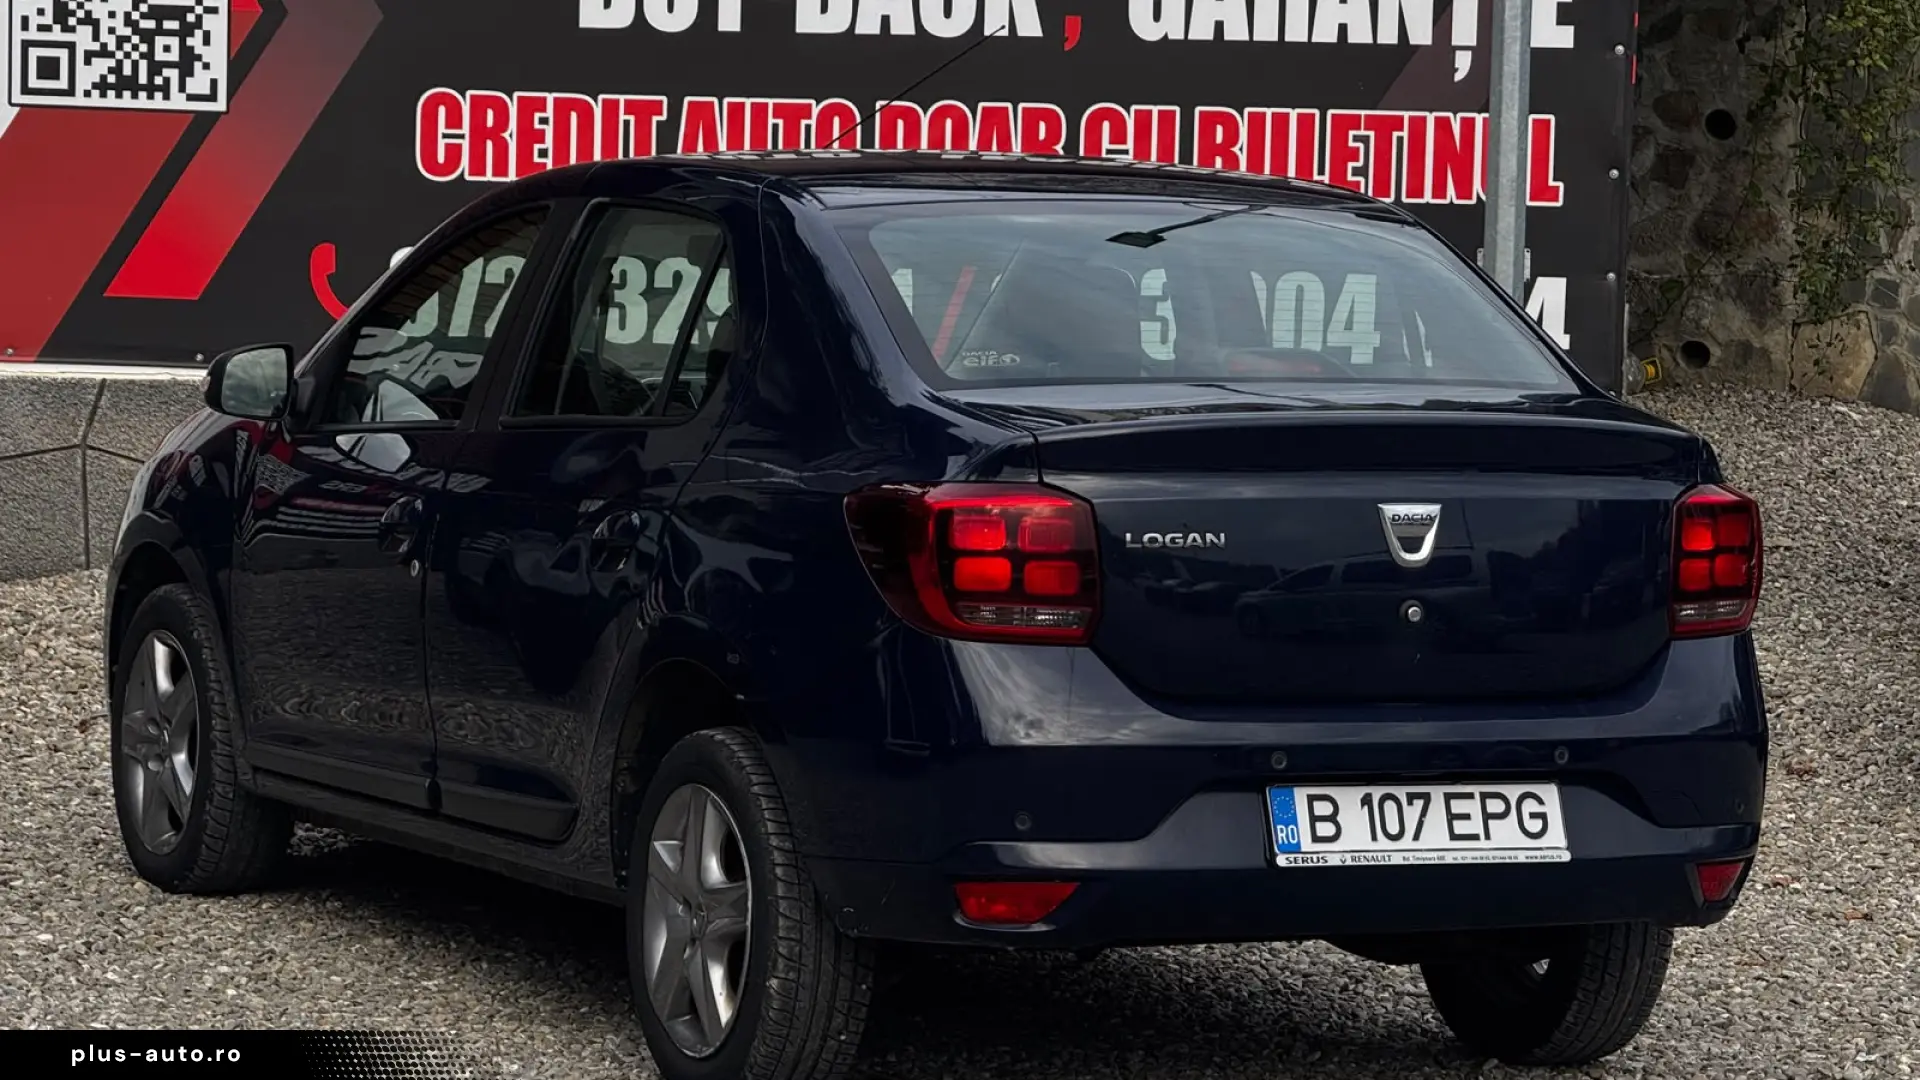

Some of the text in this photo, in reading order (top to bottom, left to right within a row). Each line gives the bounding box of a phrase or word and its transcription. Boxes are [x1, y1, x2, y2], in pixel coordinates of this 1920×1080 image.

[415, 86, 667, 182] CREDIT
[677, 96, 862, 155] AUTO
[1193, 106, 1564, 206] BULETINL
[1391, 513, 1434, 523] DACIA
[1125, 532, 1226, 549] LOGAN
[1306, 791, 1550, 844] B 107 EPG
[1277, 823, 1299, 845] RO
[1284, 855, 1330, 866] SERUS
[1349, 853, 1393, 864] RENAULT
